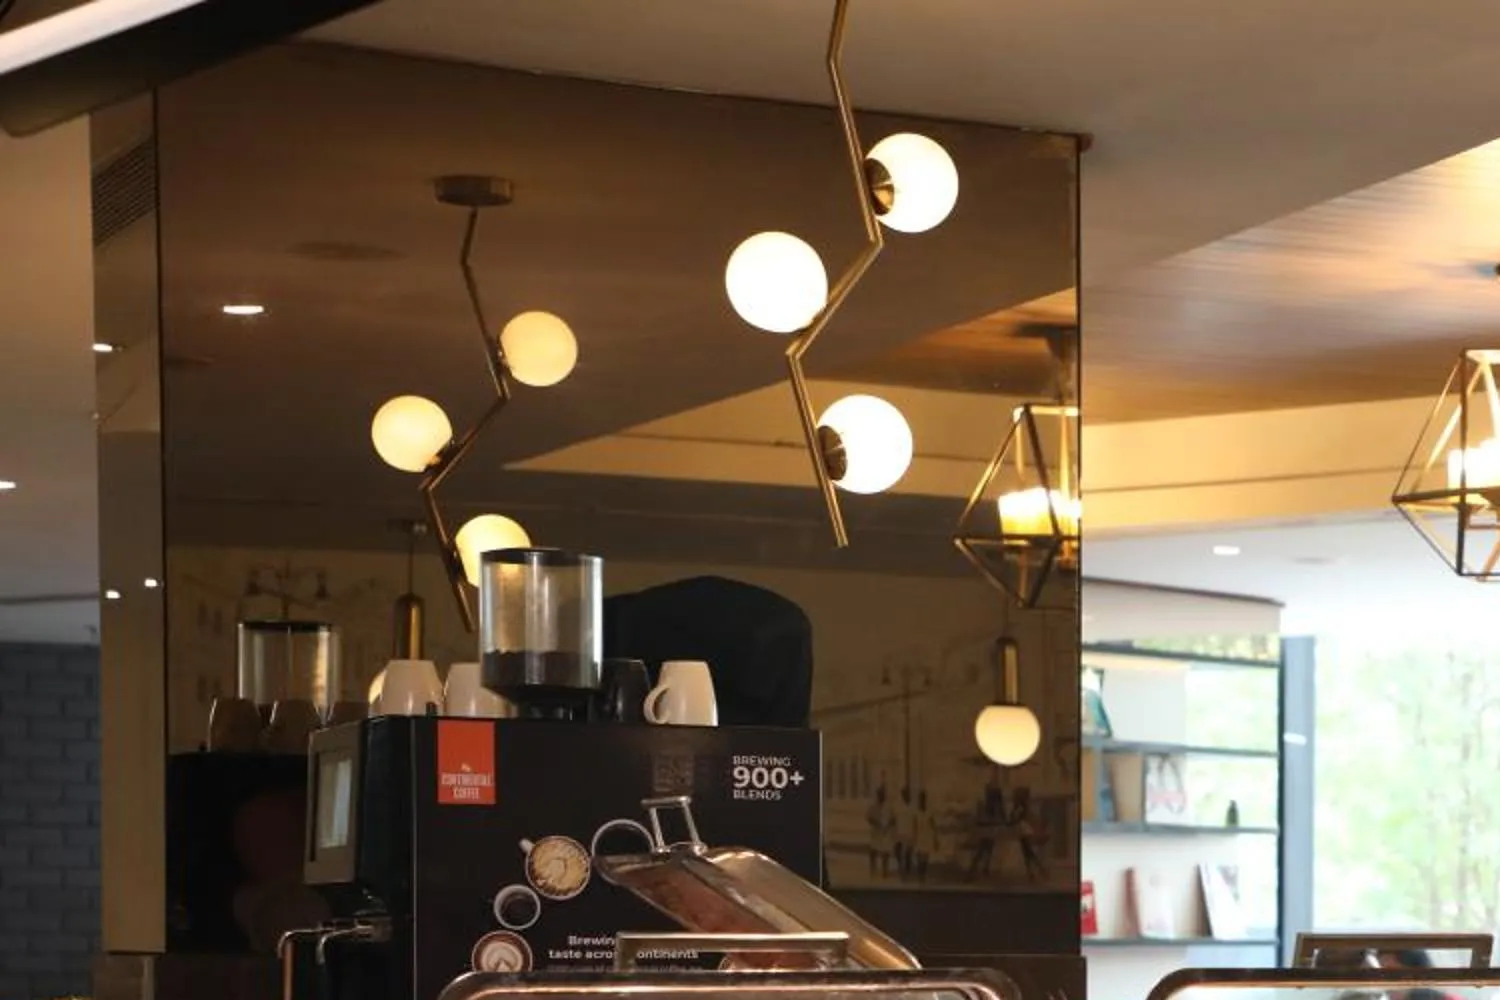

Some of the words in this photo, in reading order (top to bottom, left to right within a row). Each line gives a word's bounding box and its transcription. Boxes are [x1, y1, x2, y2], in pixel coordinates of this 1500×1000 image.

[732, 755, 791, 767] BREWING
[733, 766, 805, 788] 900+
[733, 789, 782, 800] BLENDS
[568, 935, 616, 946] Brewin
[549, 949, 583, 959] taste
[636, 949, 699, 959] ontinents
